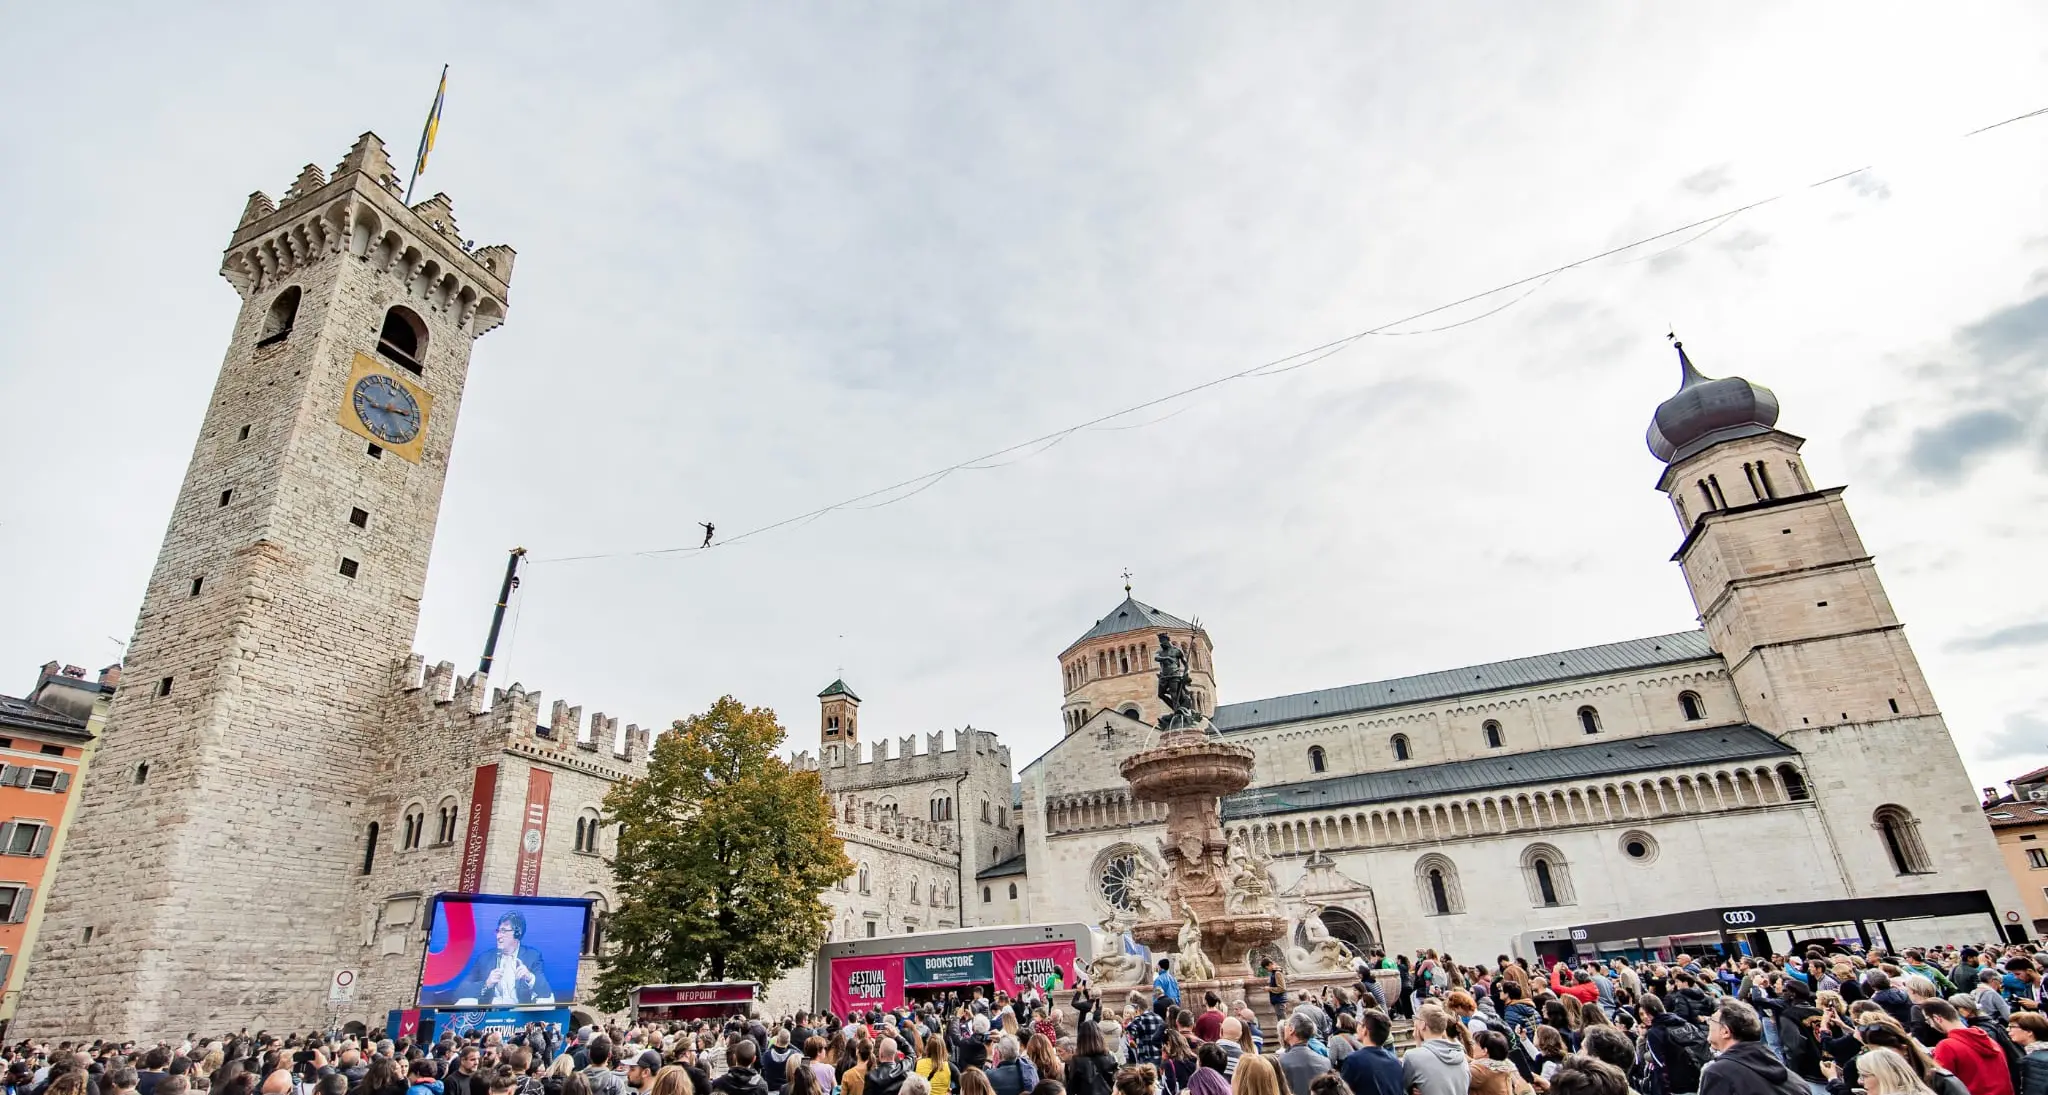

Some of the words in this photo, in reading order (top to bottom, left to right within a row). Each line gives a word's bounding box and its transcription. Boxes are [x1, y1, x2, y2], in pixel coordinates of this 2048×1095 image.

[466, 803, 482, 866] DIOCESANO
[525, 859, 538, 897] MUSEO
[925, 955, 974, 970] BOOKSTORE
[1017, 957, 1055, 974] FESTIVAL
[851, 969, 887, 985] FESTIVAL
[676, 990, 718, 1001] INFOPOINT
[860, 983, 887, 999] SPORT
